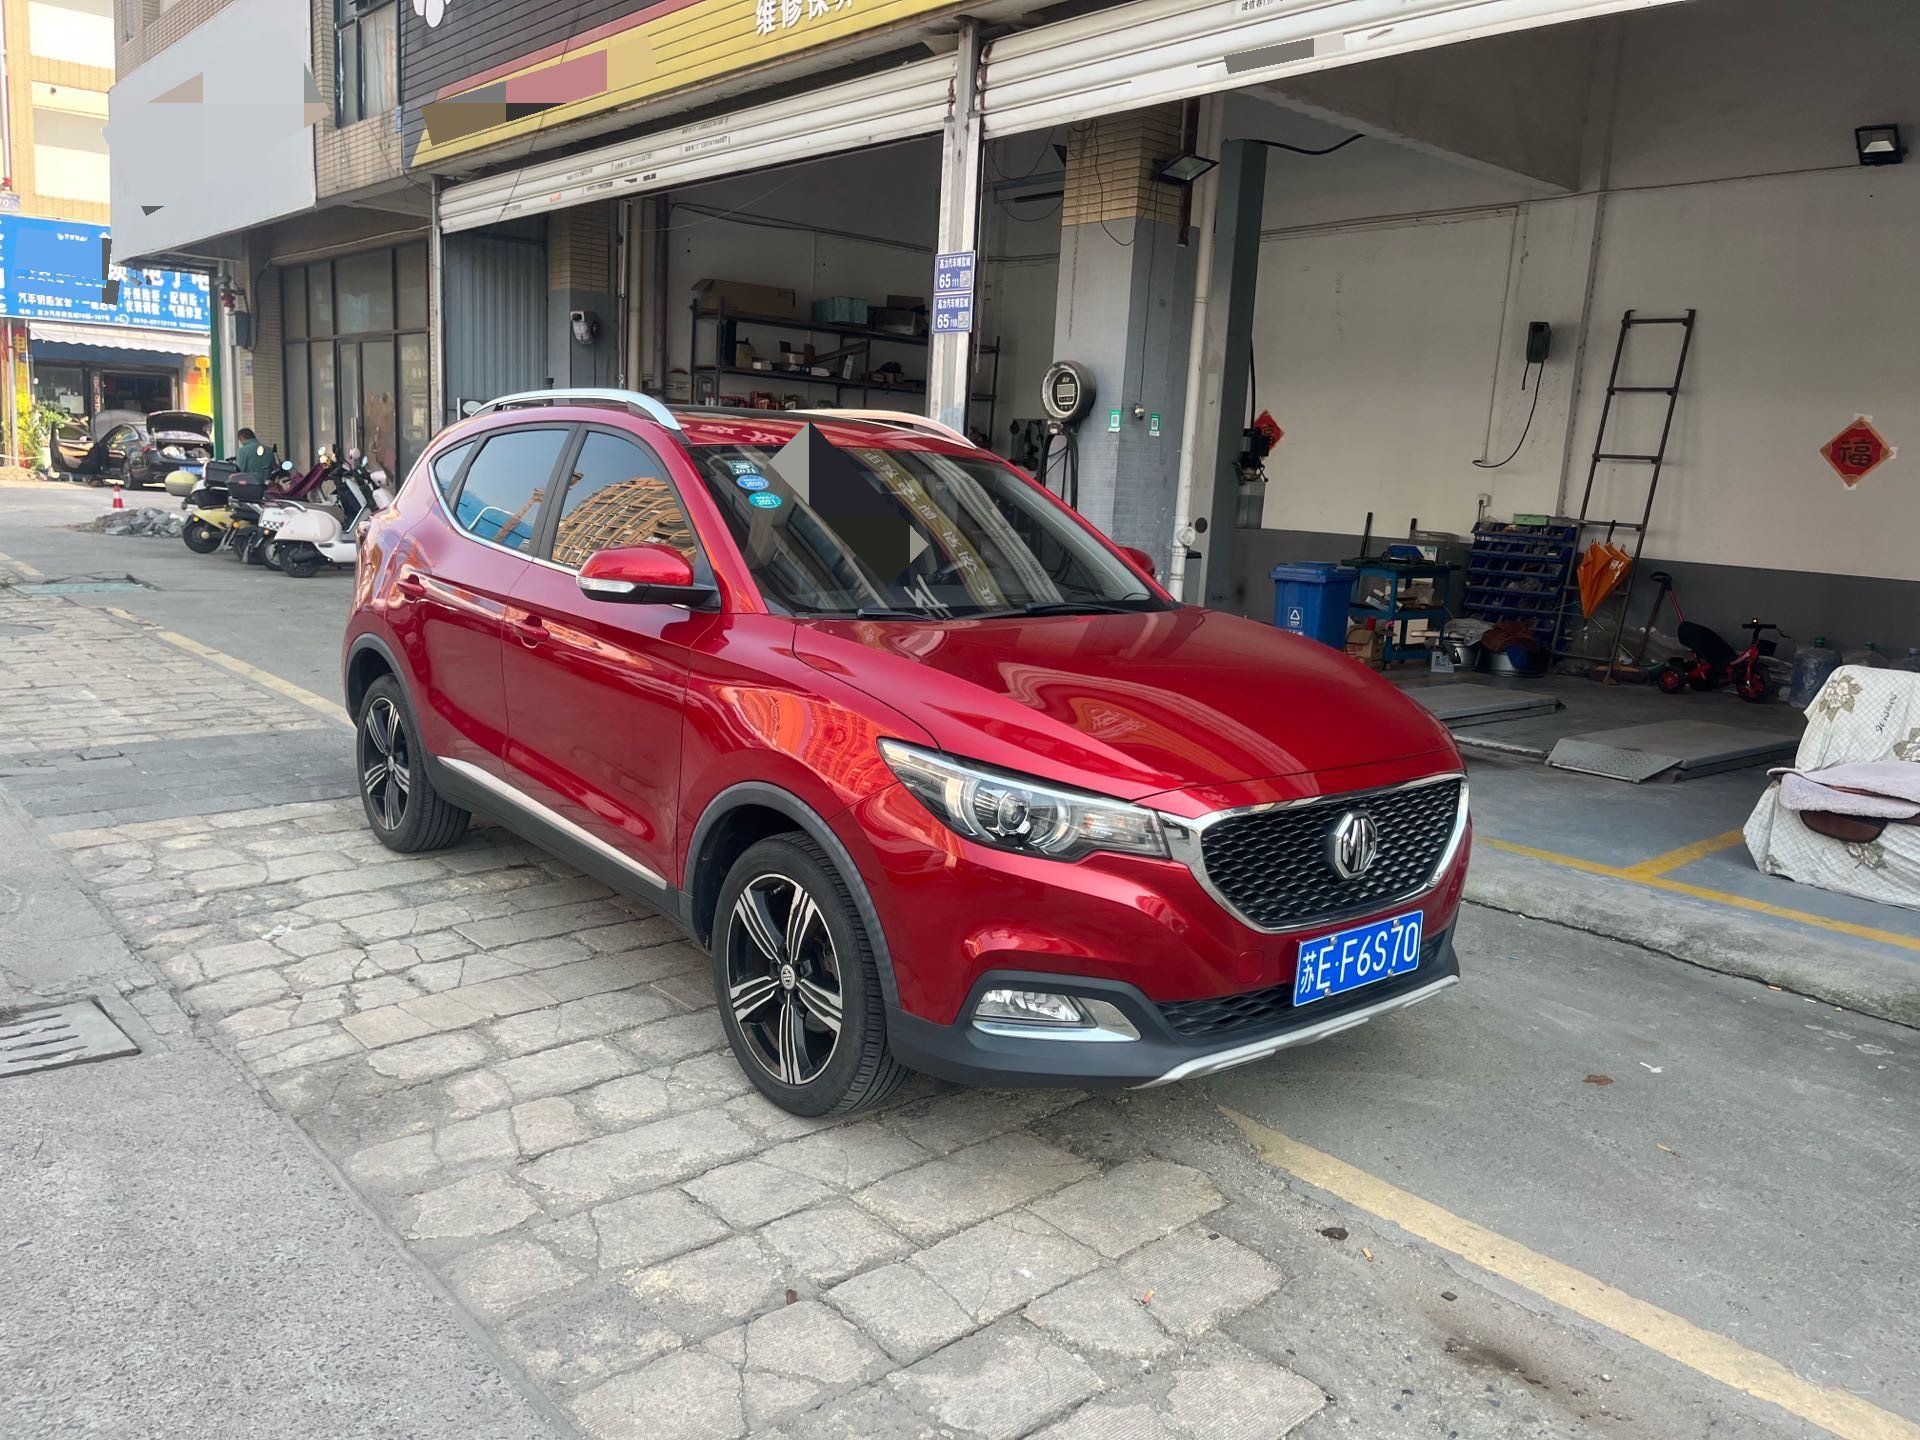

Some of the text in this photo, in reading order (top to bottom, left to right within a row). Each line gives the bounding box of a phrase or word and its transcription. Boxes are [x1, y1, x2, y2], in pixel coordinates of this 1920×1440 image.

[756, 0, 853, 35] 维修保
[939, 273, 951, 288] 65
[937, 313, 949, 328] 65
[1839, 438, 1872, 467] 福
